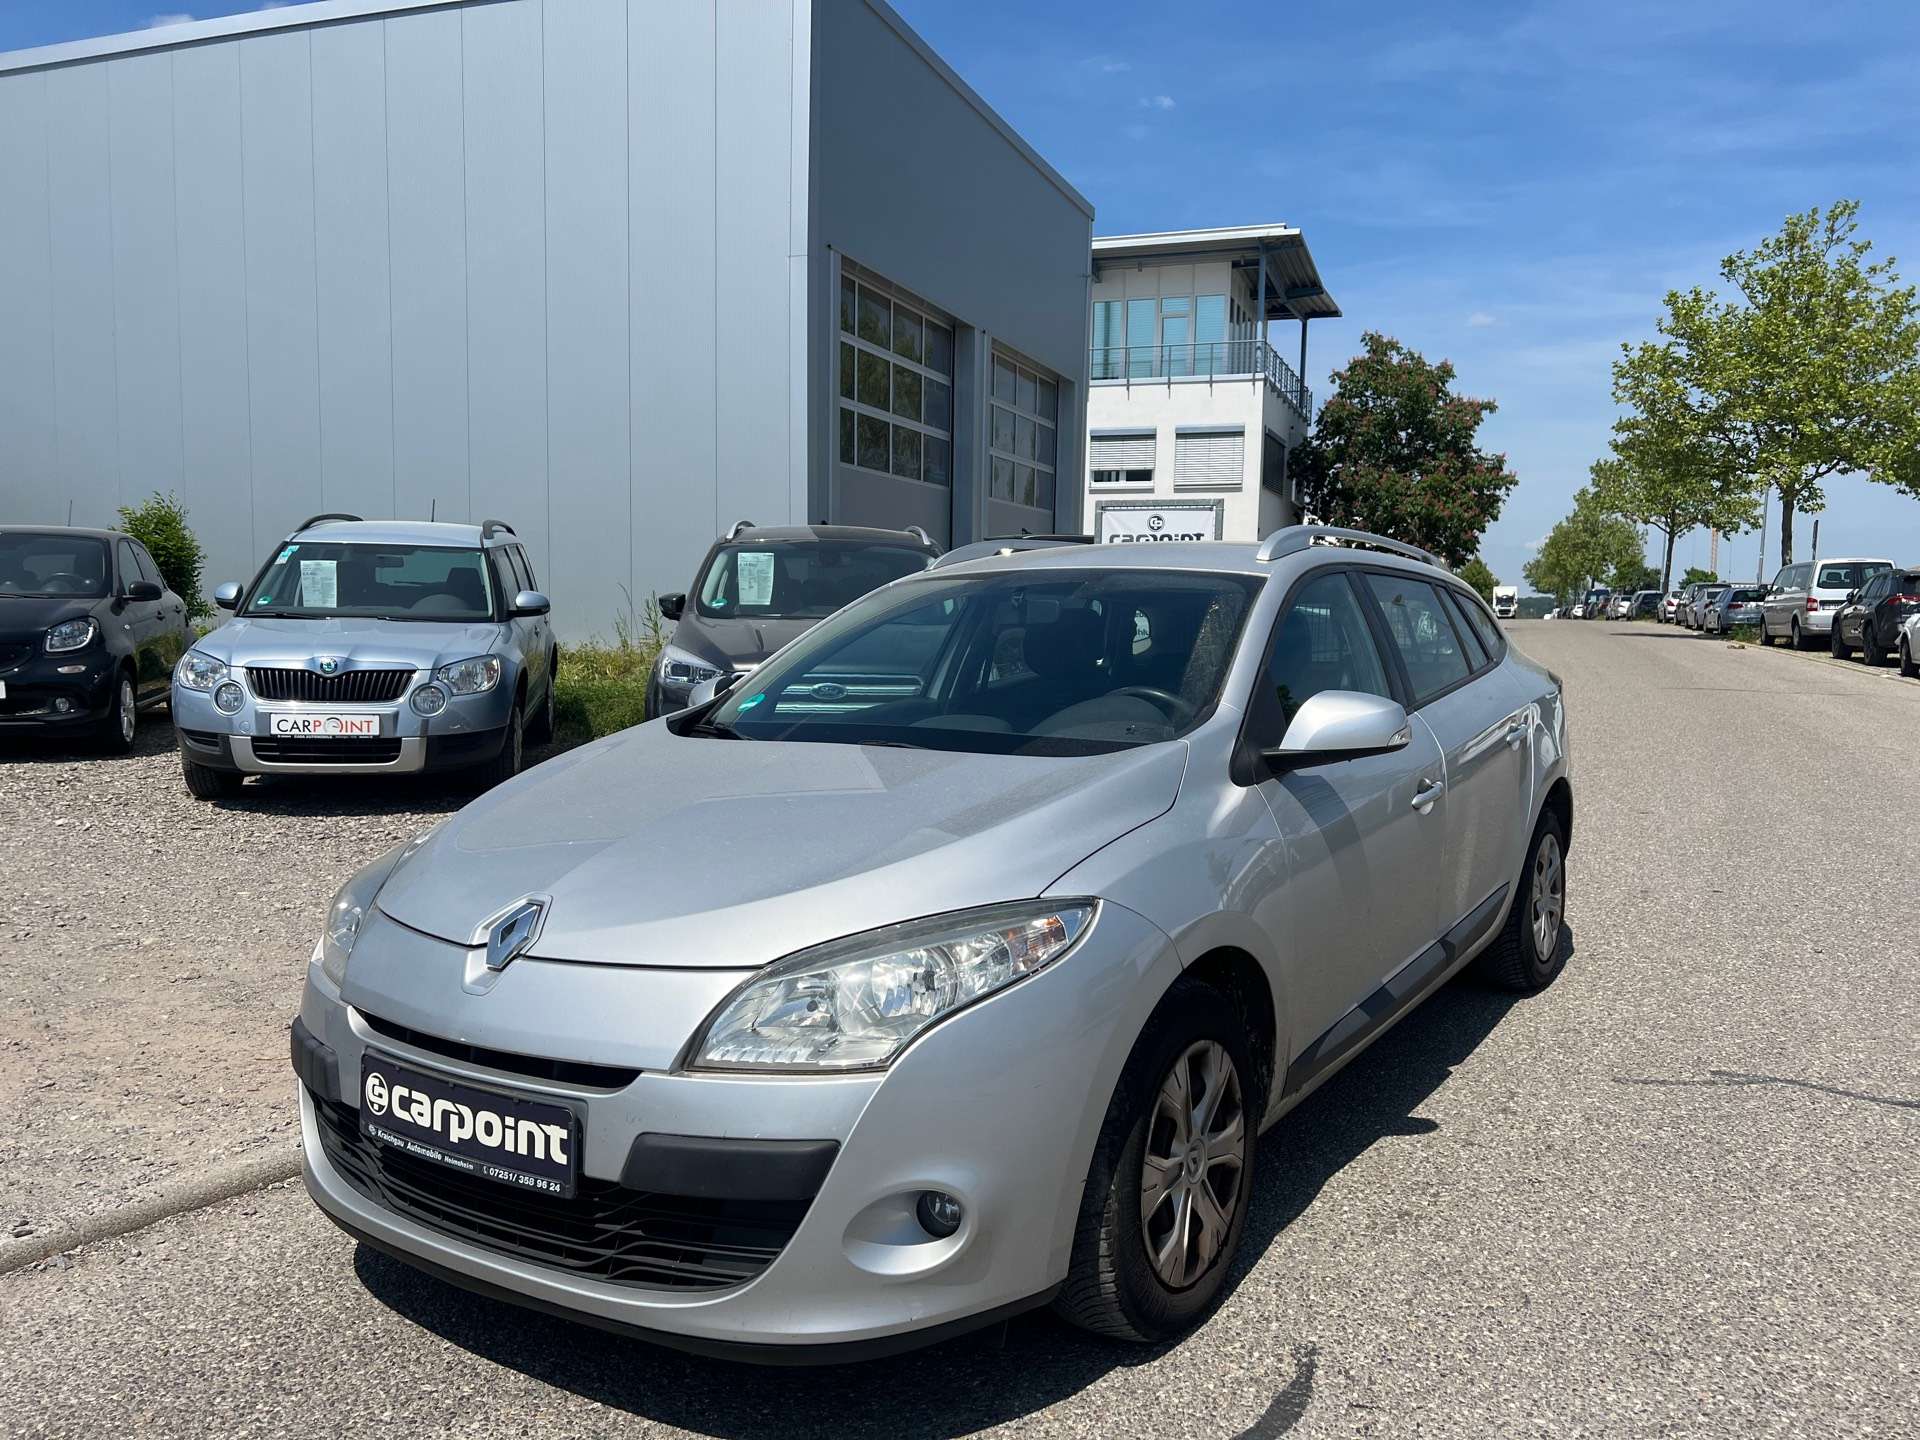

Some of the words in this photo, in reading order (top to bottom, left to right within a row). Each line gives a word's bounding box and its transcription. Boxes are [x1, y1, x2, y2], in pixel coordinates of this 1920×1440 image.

[276, 717, 373, 733] CARPOINT
[391, 1085, 568, 1165] carpoint
[406, 1142, 442, 1161] Automobile
[518, 1175, 535, 1186] 358
[536, 1180, 548, 1189] 96
[549, 1182, 561, 1193] 24
